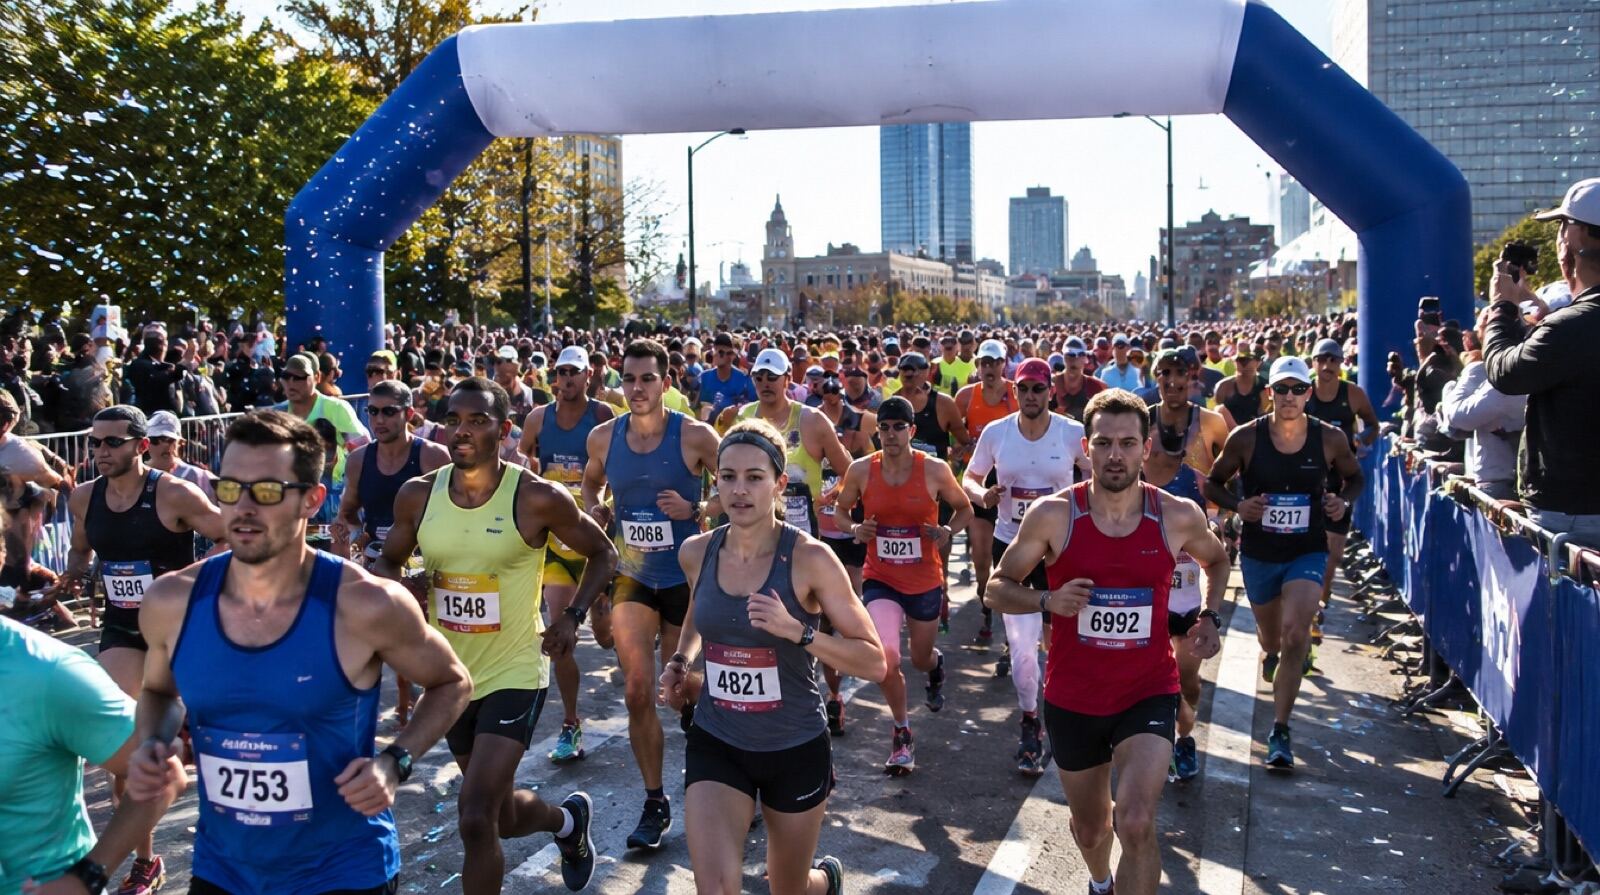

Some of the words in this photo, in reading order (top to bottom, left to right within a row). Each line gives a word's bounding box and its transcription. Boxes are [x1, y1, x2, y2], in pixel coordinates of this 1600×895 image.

[629, 525, 664, 542] 2068
[882, 540, 914, 556] 3021
[444, 595, 486, 619] 1548
[1090, 611, 1140, 633] 6992
[717, 670, 765, 696] 4821
[218, 766, 289, 802] 2753
